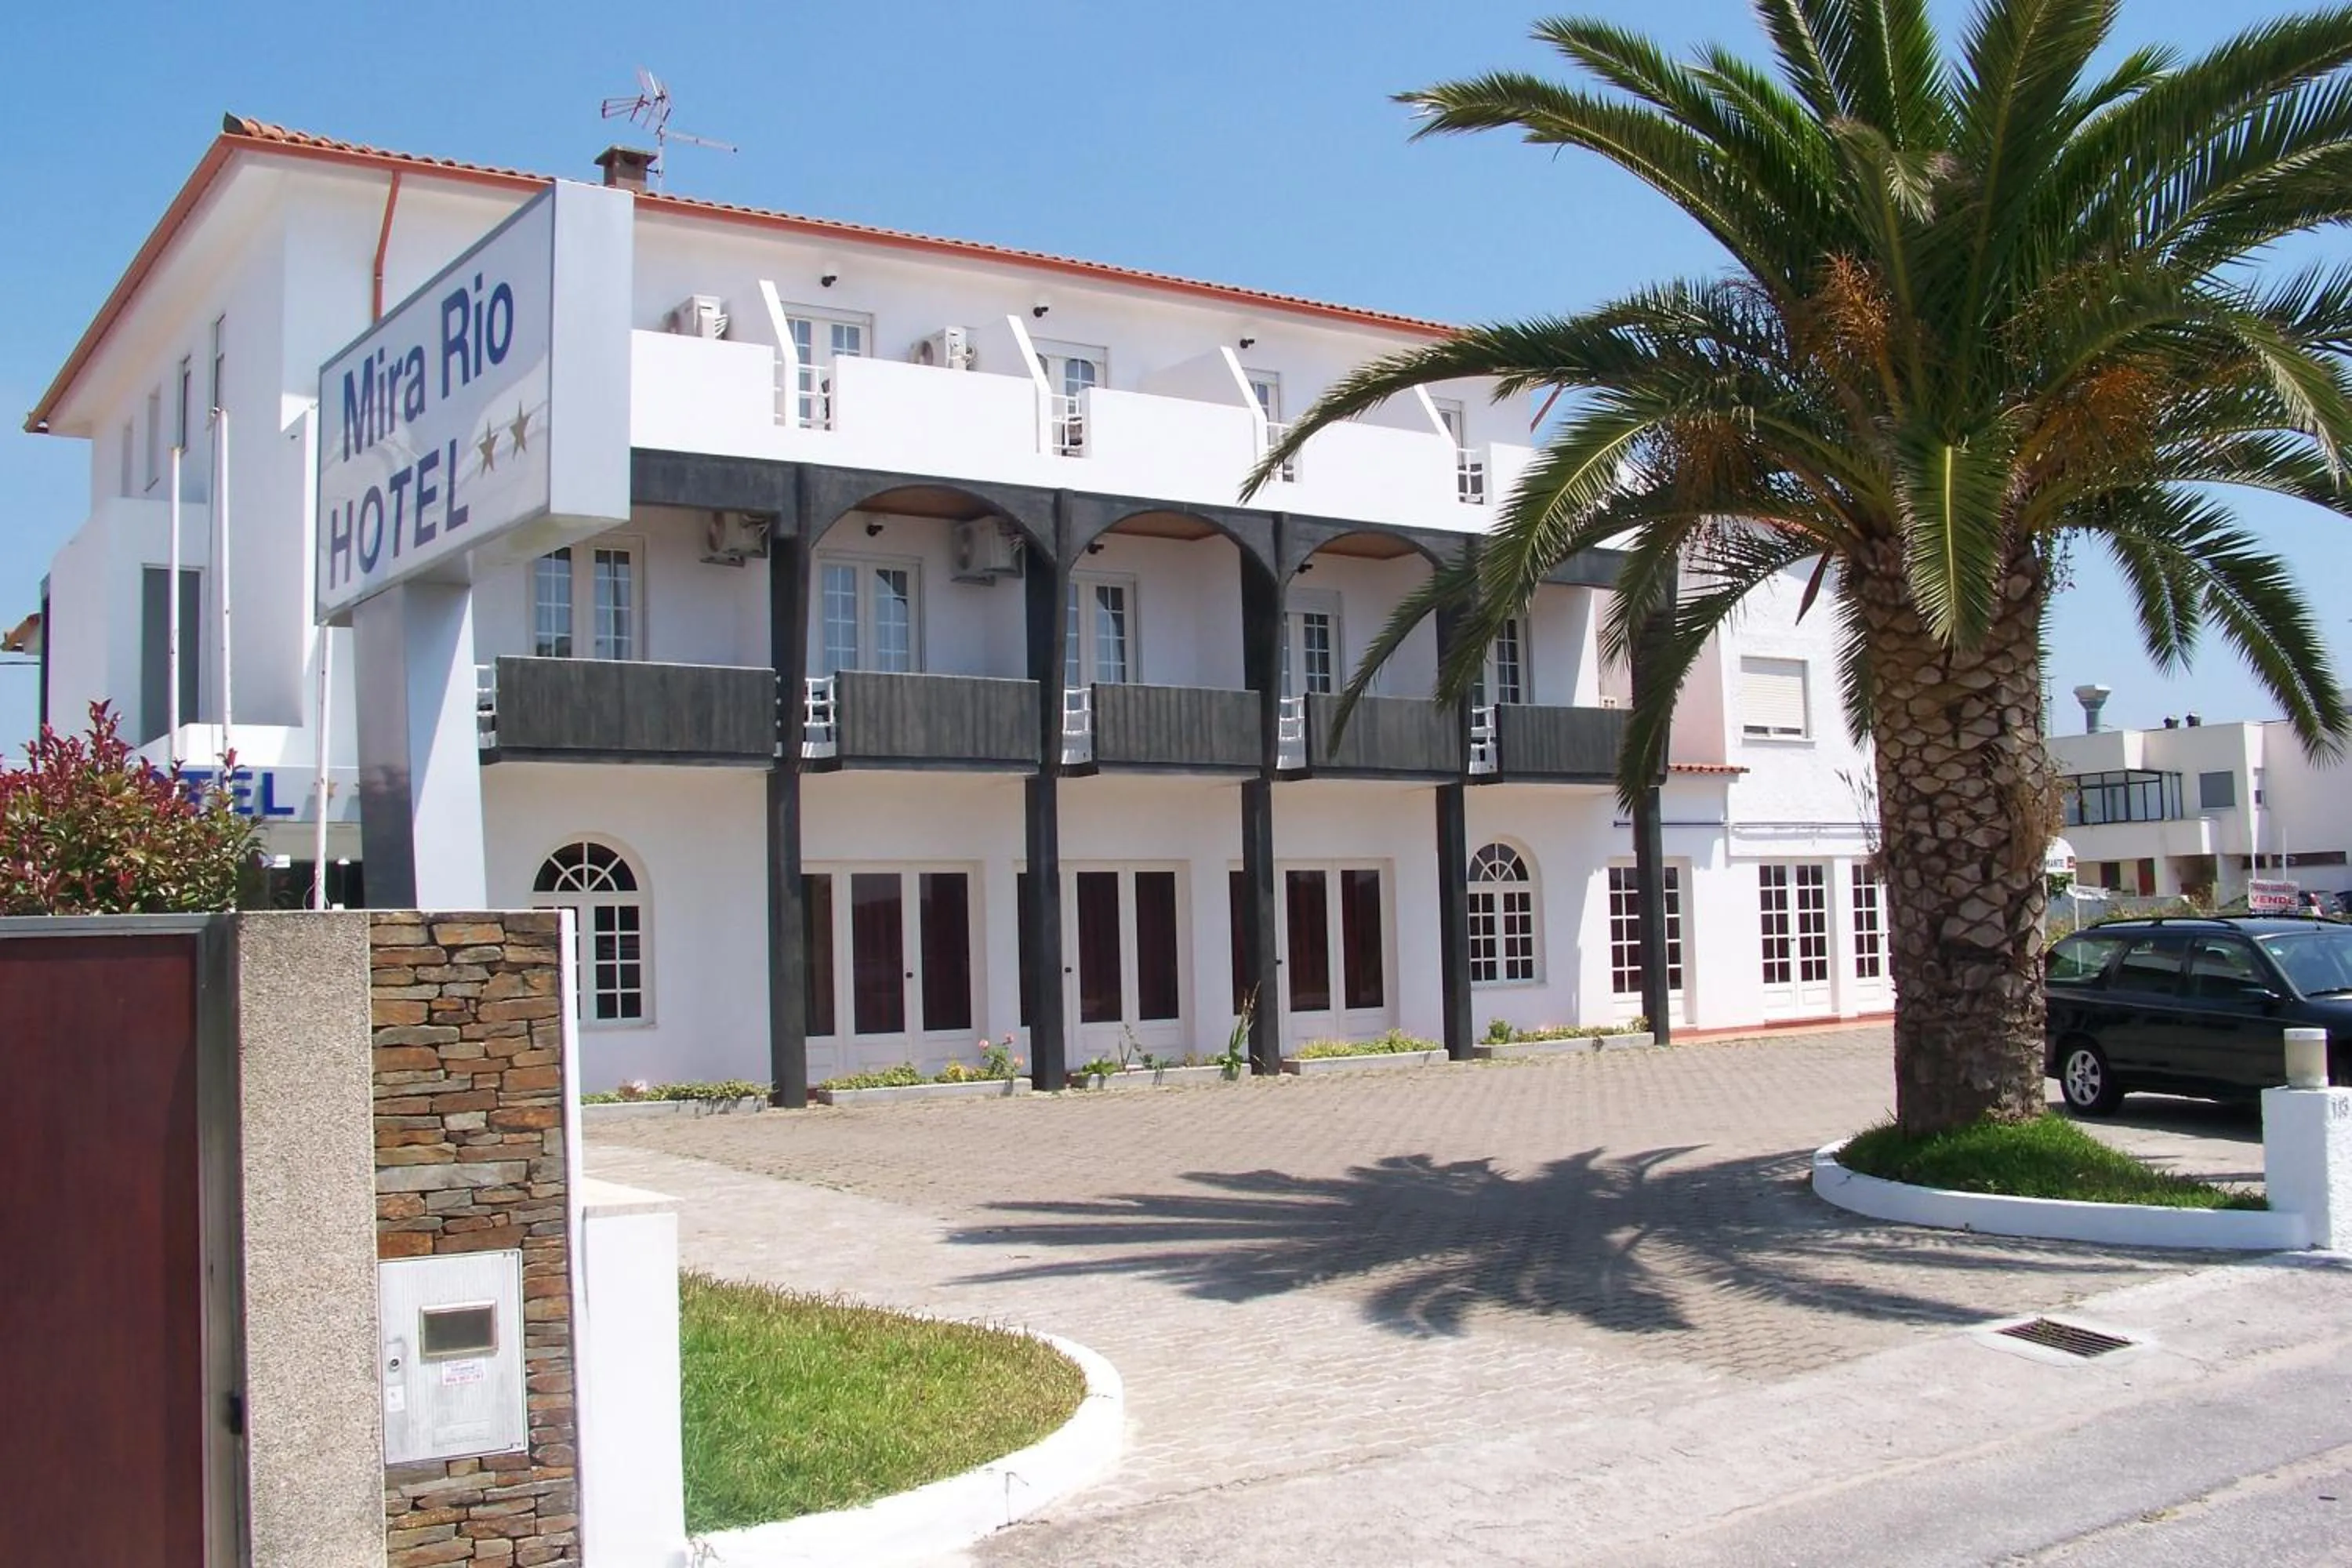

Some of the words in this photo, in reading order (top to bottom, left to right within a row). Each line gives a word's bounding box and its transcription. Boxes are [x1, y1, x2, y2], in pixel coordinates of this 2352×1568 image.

[343, 345, 425, 461] Mira
[441, 272, 514, 398] Rio
[329, 439, 469, 590] HOTEL
[151, 771, 295, 815] TEL
